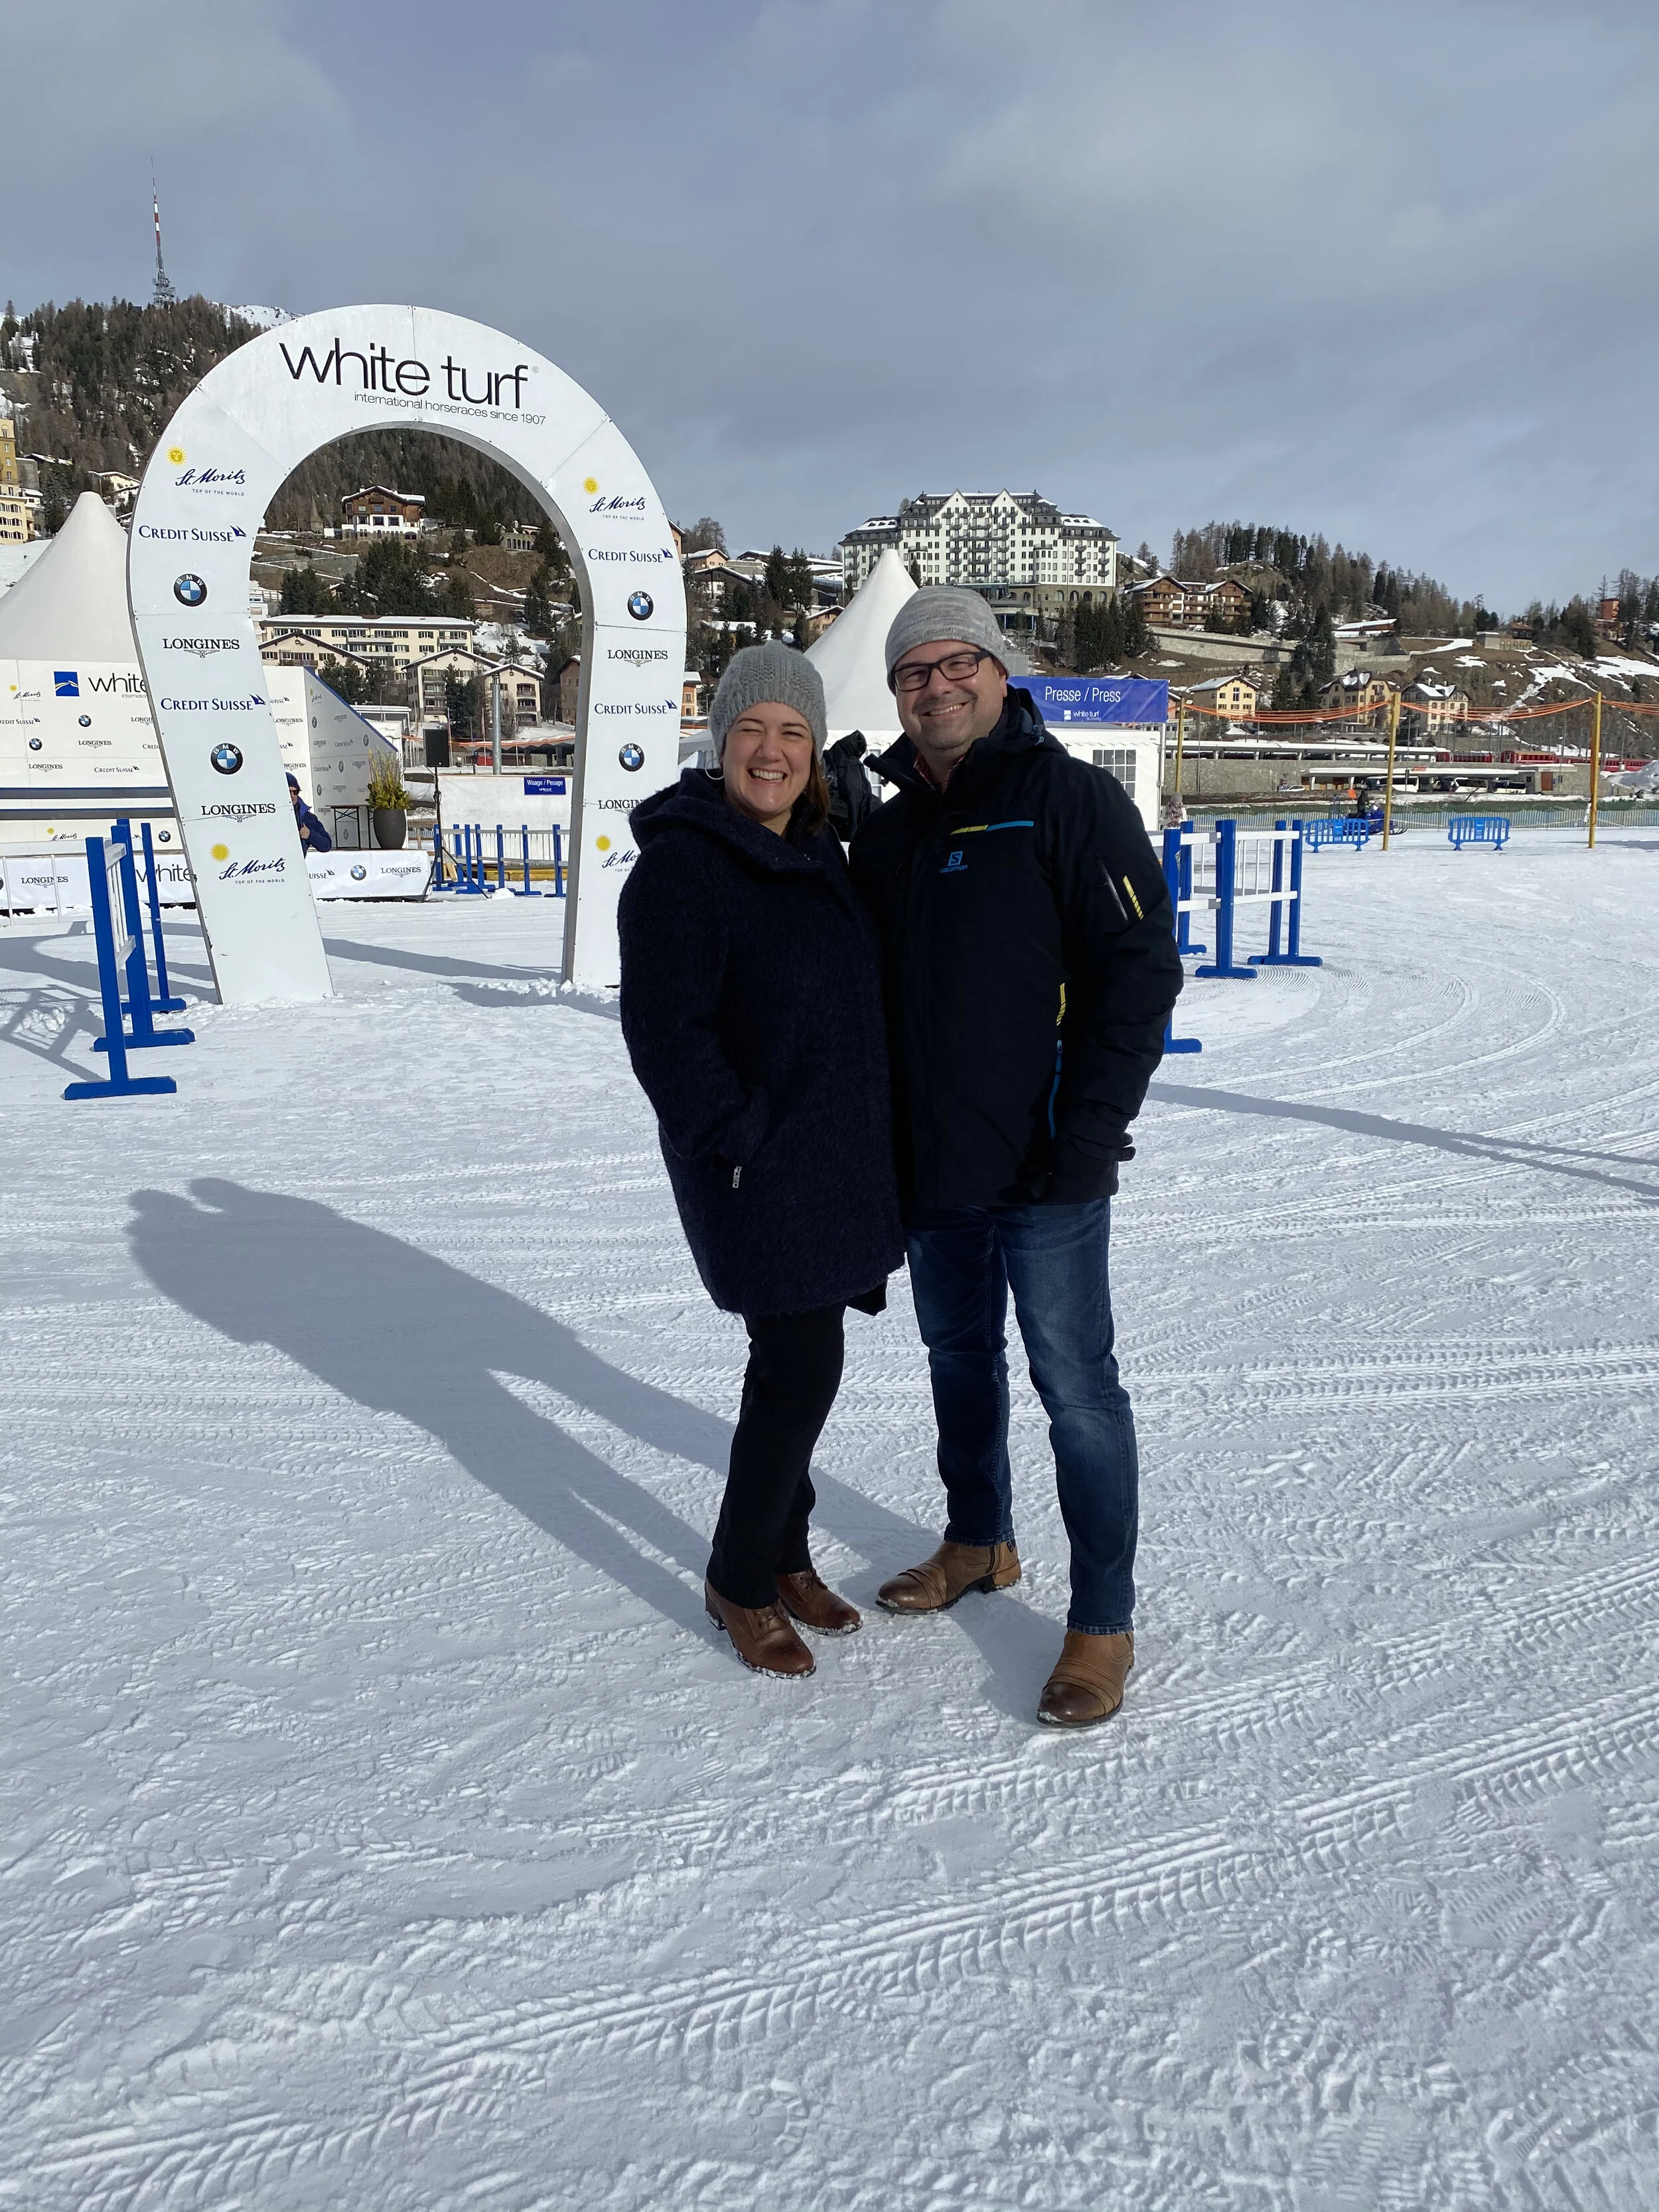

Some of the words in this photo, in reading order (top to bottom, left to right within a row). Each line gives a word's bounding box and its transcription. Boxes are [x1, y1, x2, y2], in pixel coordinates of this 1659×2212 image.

[279, 337, 431, 396] white
[441, 355, 529, 409] turf
[354, 391, 423, 409] international
[425, 402, 488, 419] horseraces
[490, 408, 518, 422] since
[520, 413, 546, 425] 1907
[192, 468, 246, 485] Moritz
[603, 496, 646, 512] Moritz
[139, 525, 188, 540] CREDIT
[191, 528, 234, 542] SUISSE
[589, 548, 627, 561] CREDIT
[630, 550, 663, 563] SUISSE
[177, 574, 204, 586] BMW
[630, 592, 651, 603] BMW
[162, 638, 240, 650] LONGINES
[607, 650, 668, 660] LONGINES
[1045, 686, 1081, 701] Presse
[1084, 688, 1090, 702] /
[1092, 688, 1121, 703] Press
[161, 698, 209, 711] CREDIT
[212, 698, 253, 711] SUISSE
[594, 703, 632, 714] CREDIT
[635, 703, 668, 714] SUISSE
[213, 744, 240, 755] BMW
[621, 744, 643, 754] BMW
[201, 803, 275, 816] LONGINES
[598, 800, 645, 810] LONGIN
[234, 857, 285, 877] Moritz
